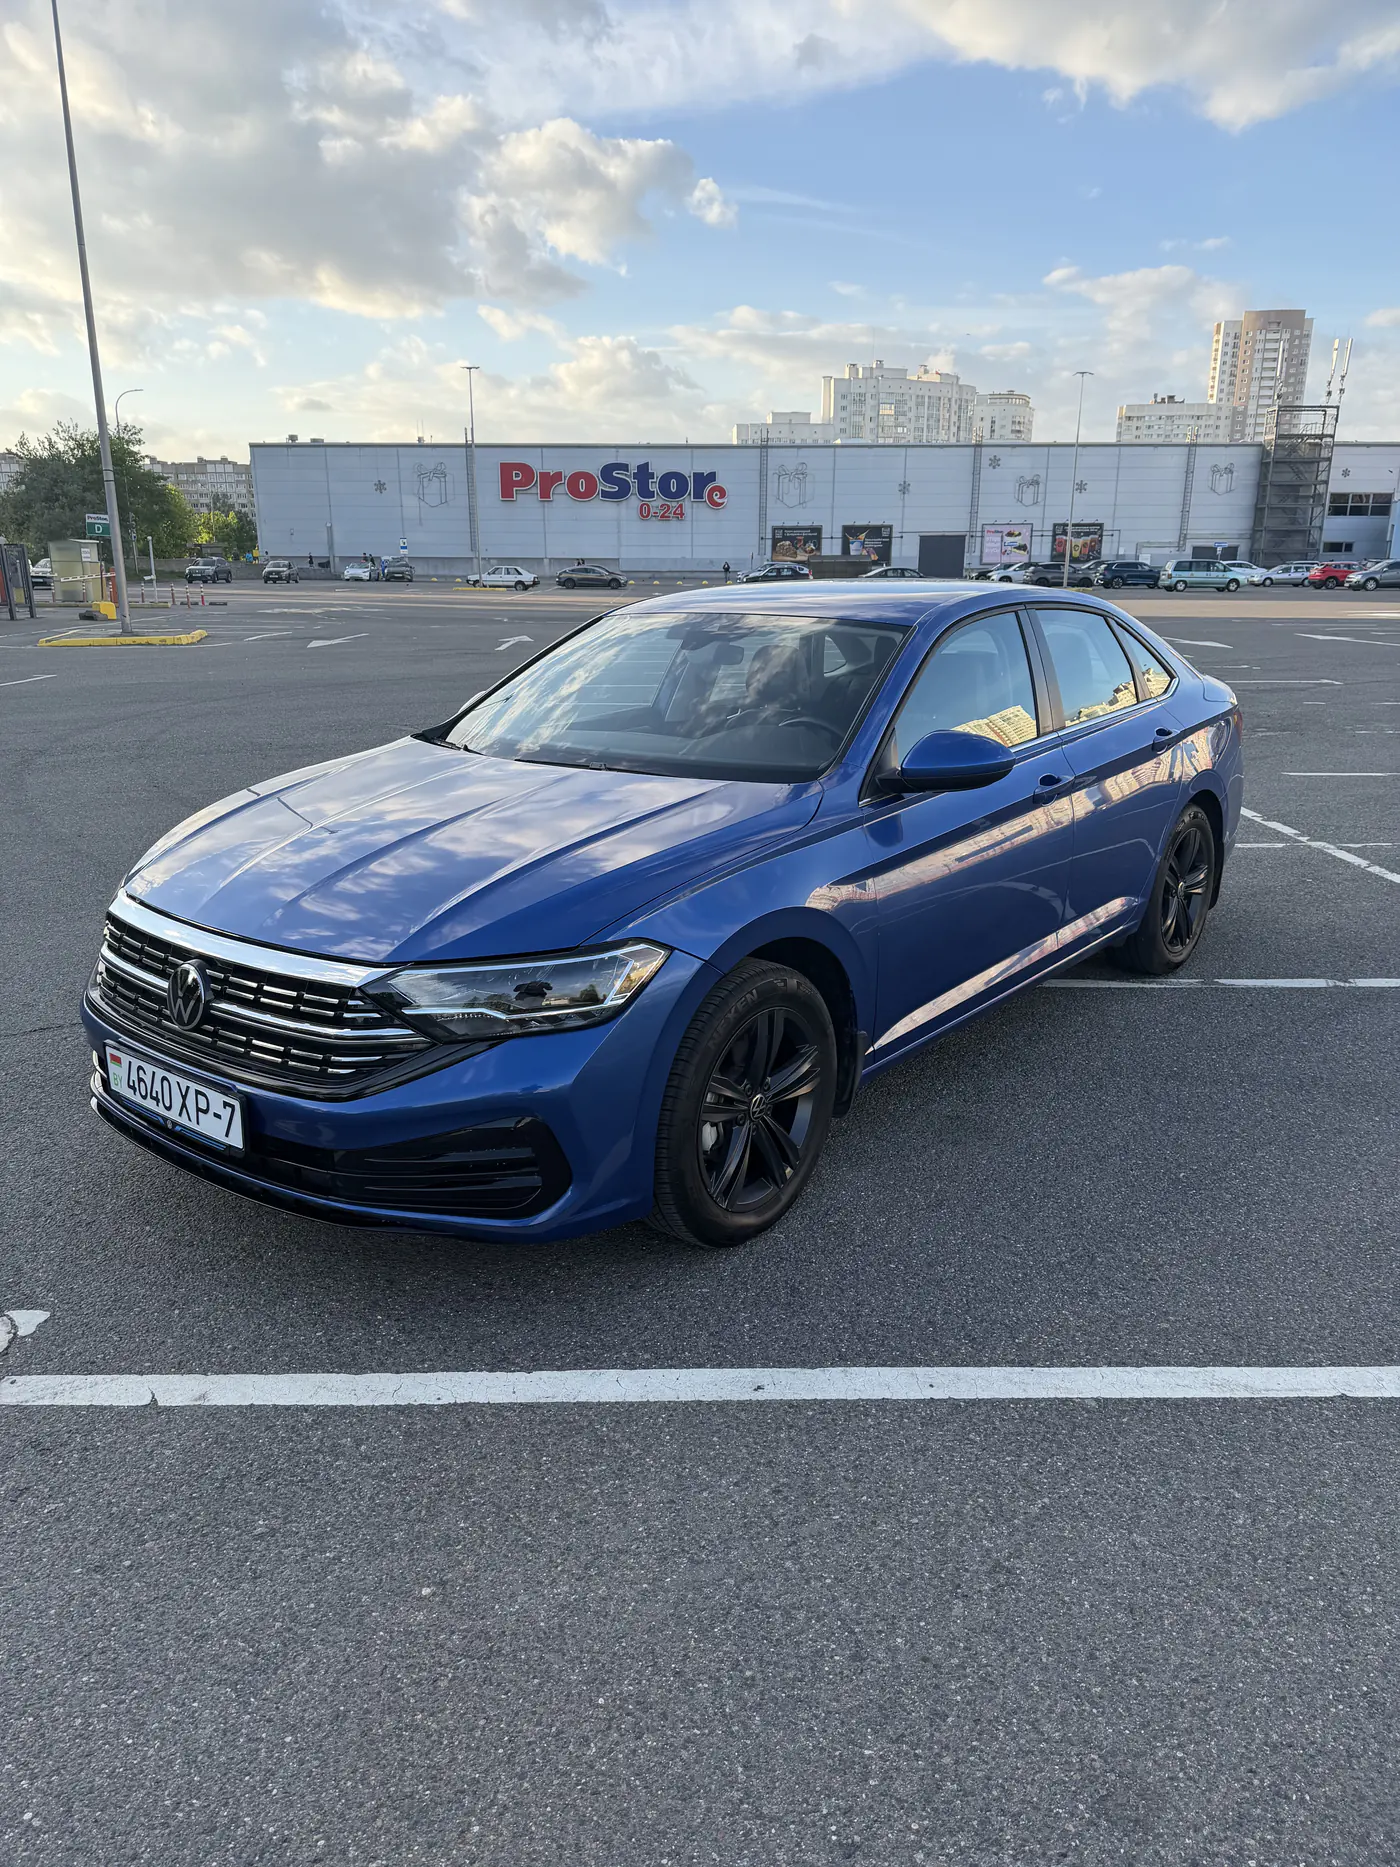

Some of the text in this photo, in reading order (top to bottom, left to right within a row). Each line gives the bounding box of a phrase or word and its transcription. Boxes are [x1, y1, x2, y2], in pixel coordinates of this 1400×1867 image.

[499, 461, 728, 509] ProStore
[639, 502, 685, 520] 0-24
[95, 524, 103, 533] D
[707, 988, 759, 1049] NEXEN
[112, 1072, 123, 1088] BY
